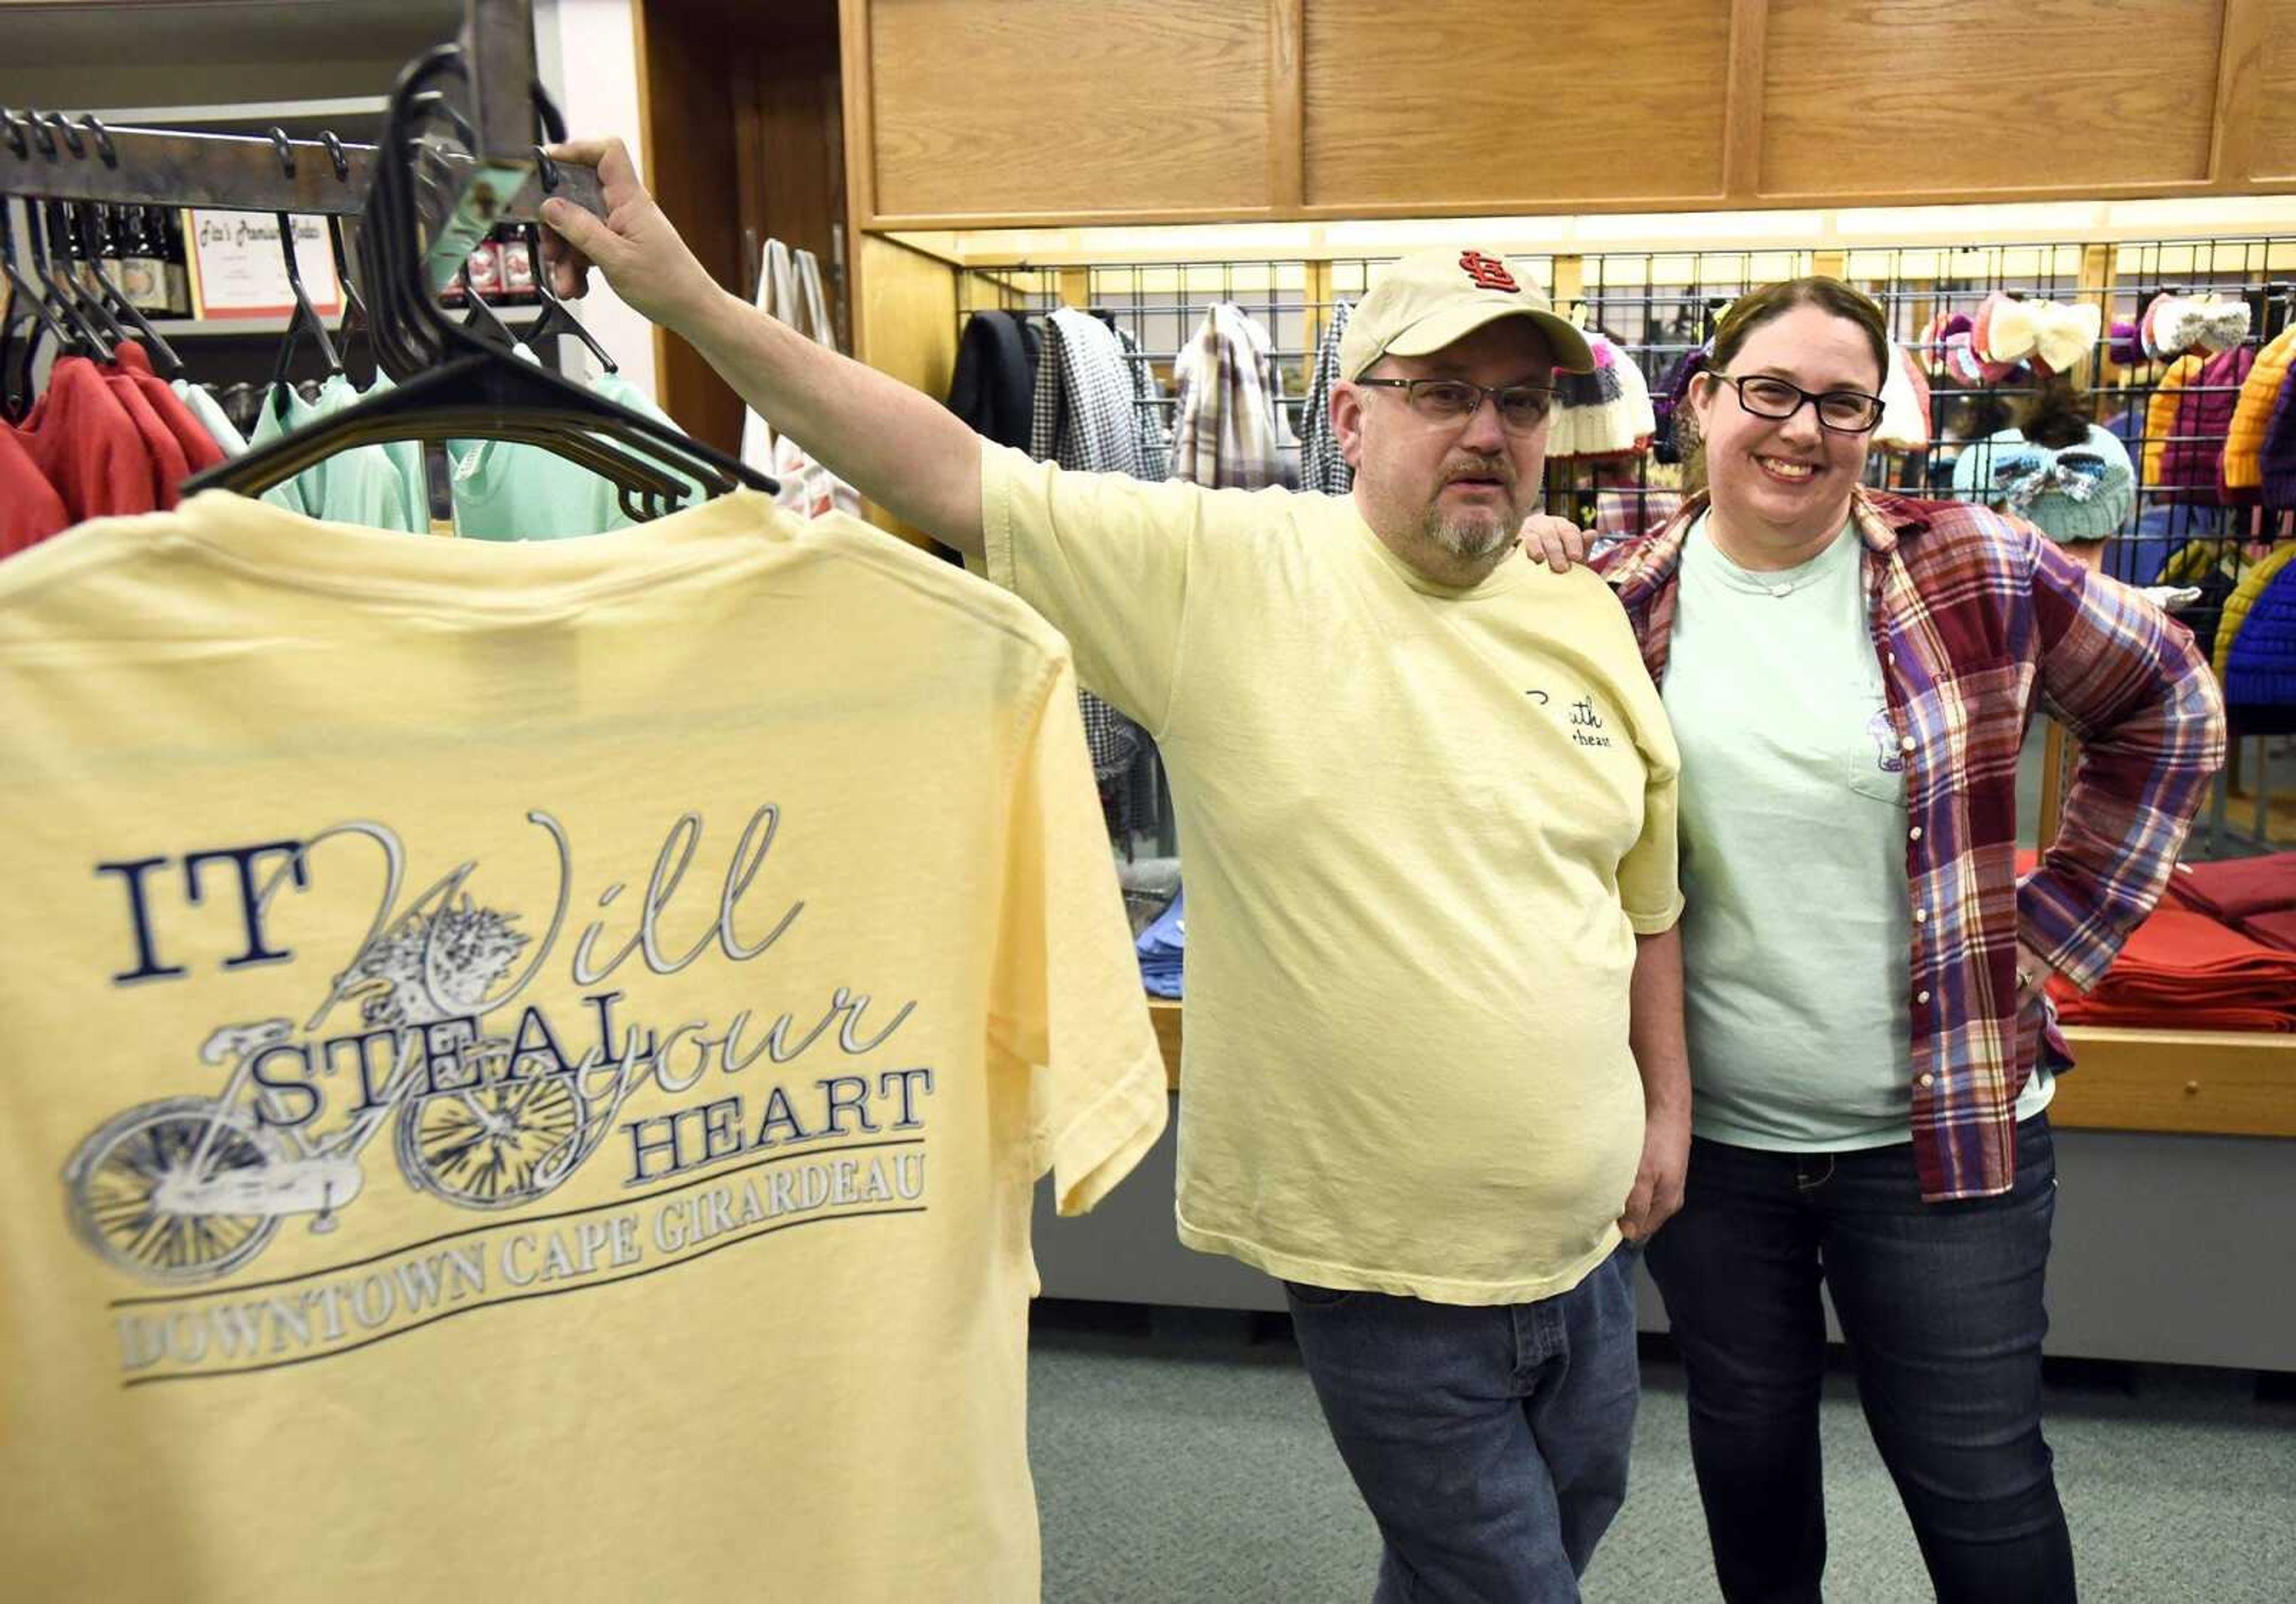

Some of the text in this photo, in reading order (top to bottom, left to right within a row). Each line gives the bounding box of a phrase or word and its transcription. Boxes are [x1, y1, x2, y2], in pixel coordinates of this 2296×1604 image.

[96, 803, 805, 1031] IT Will
[250, 988, 917, 1189] STEAL your
[621, 1067, 934, 1189] HEART
[115, 1153, 927, 1370] DOWNTOWN CAPE GIRARDEAU
